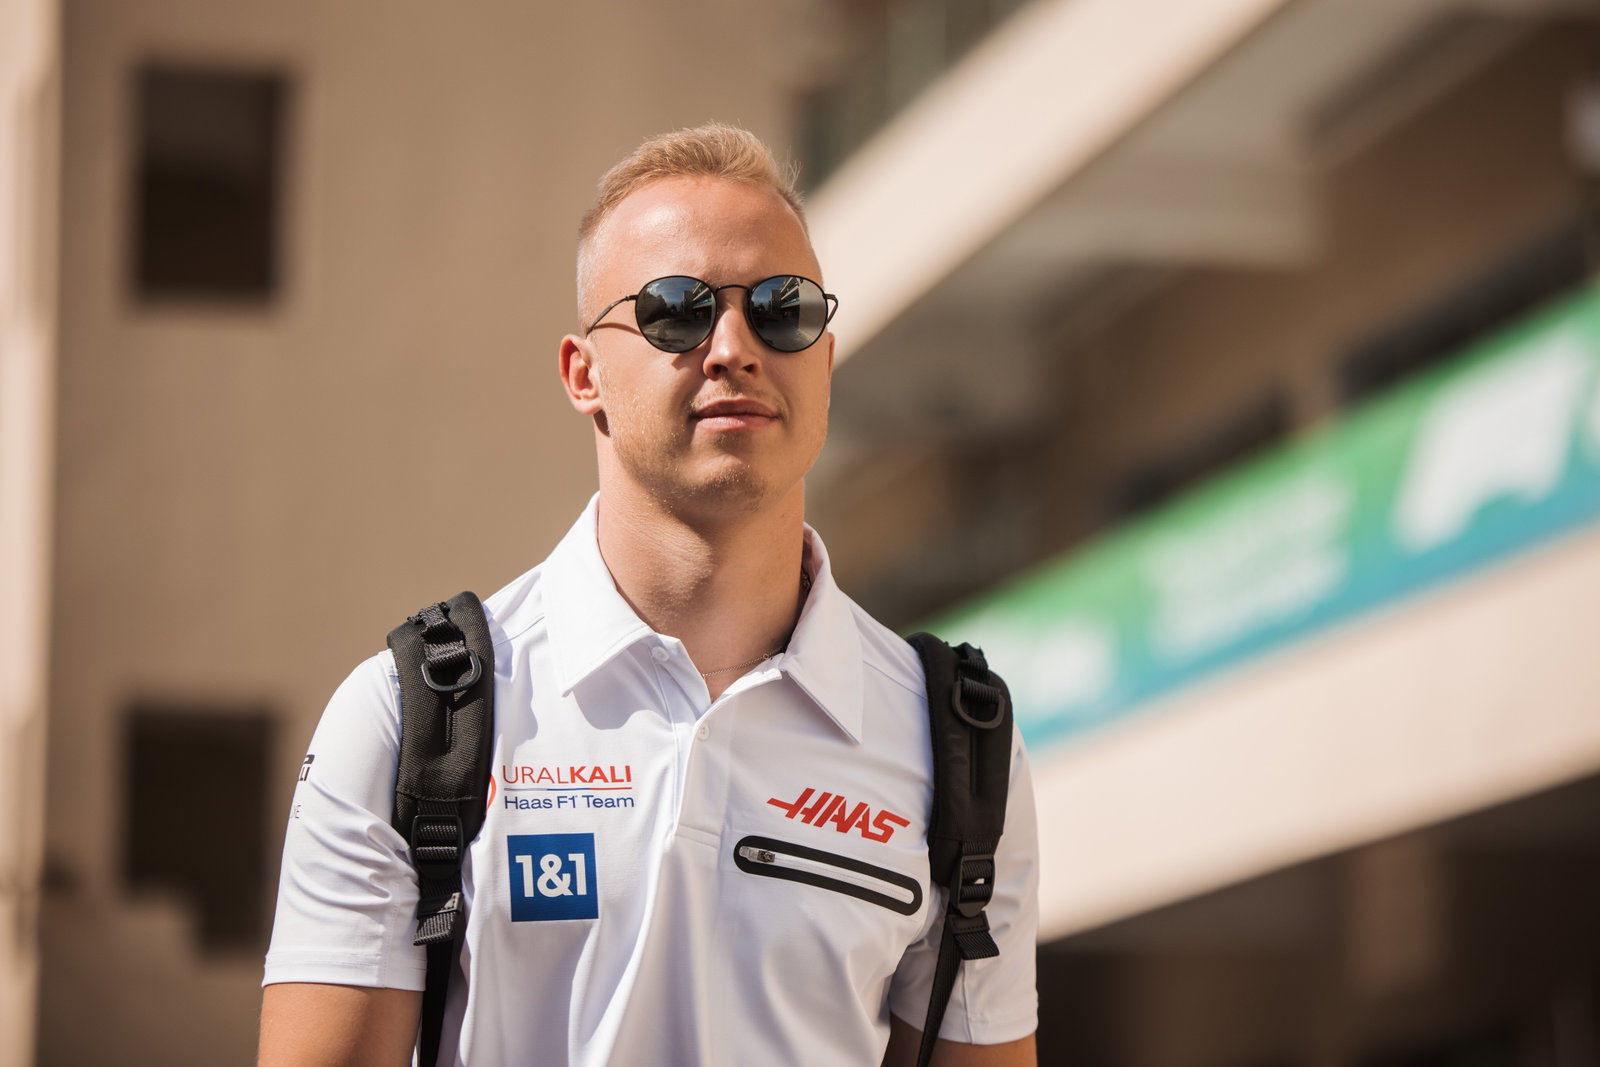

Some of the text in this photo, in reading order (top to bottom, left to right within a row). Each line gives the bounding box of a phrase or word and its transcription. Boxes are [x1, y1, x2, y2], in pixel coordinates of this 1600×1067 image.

[502, 764, 633, 785] URALKALI
[504, 794, 636, 810] Haas F1 Team
[766, 787, 911, 844] HAAS
[515, 852, 588, 898] 1&1
